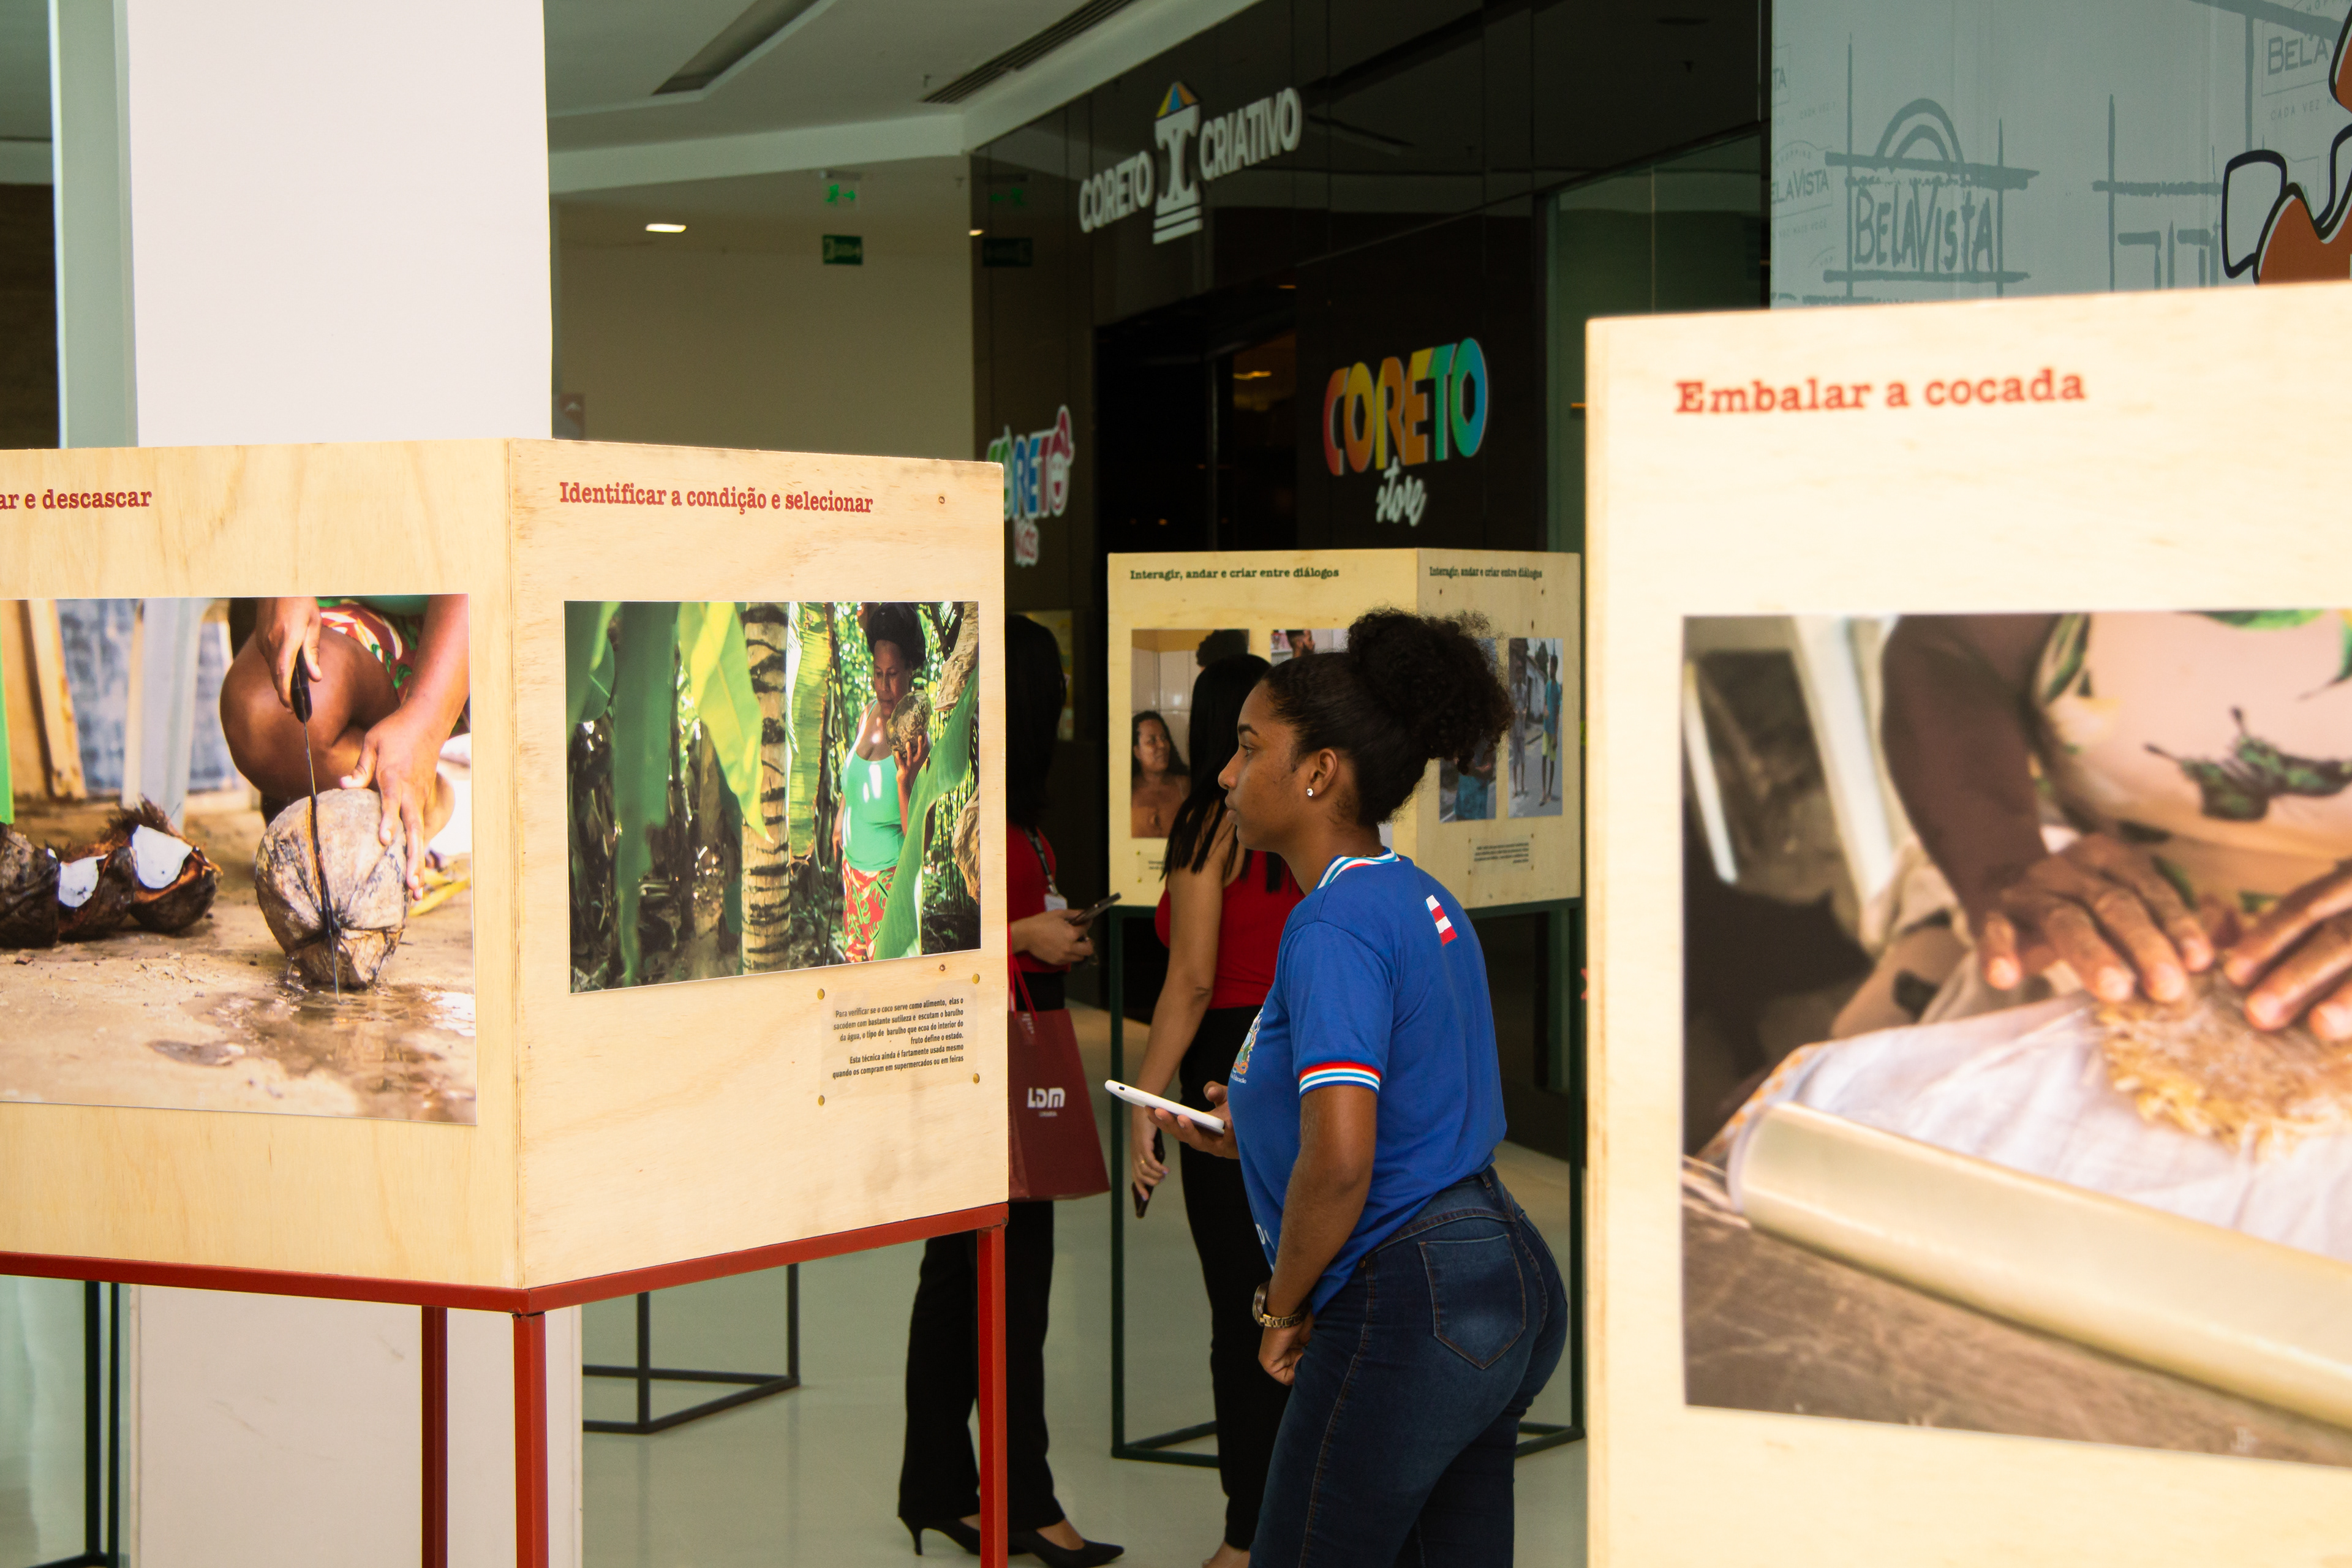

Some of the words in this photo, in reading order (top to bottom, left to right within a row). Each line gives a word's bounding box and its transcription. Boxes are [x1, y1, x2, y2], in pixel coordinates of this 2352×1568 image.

[2271, 106, 2296, 121] CADA
[2302, 99, 2320, 113] VEZ
[1079, 151, 1154, 233] CORETO
[1199, 88, 1302, 181] CRIATIVO
[1854, 183, 1994, 274] BELAVISTA
[1675, 378, 1872, 414] Embalar
[1887, 381, 1910, 407] a
[1924, 368, 2086, 406] cocada
[1323, 337, 1488, 477] CORETO
[0, 494, 20, 510] ar
[25, 493, 36, 509] e
[42, 489, 153, 510] descascar
[560, 482, 666, 505] Identificar
[671, 488, 682, 506] a
[687, 486, 767, 514] condição
[772, 492, 780, 509] e
[785, 490, 873, 513] selecionar
[1376, 456, 1427, 527] store
[1130, 569, 1183, 581] Interagir,
[1186, 569, 1218, 578] andar
[1221, 570, 1226, 578] e
[1229, 567, 1257, 578] criar
[1260, 567, 1290, 578] entre
[1293, 566, 1340, 579] diálogos
[1461, 567, 1479, 576] andar
[1480, 568, 1483, 577] e
[1485, 567, 1500, 577] criar
[1501, 568, 1517, 577] entre
[848, 1033, 861, 1042] água,
[867, 1030, 876, 1039] tipo
[887, 1027, 906, 1035] barulho
[946, 1031, 963, 1040] estado.
[862, 1054, 880, 1062] técnica
[882, 1051, 895, 1060] ainda
[901, 1048, 929, 1057] fartamente
[833, 1069, 852, 1079] quando
[861, 1066, 884, 1074] compram
[894, 1059, 932, 1071] supermercados
